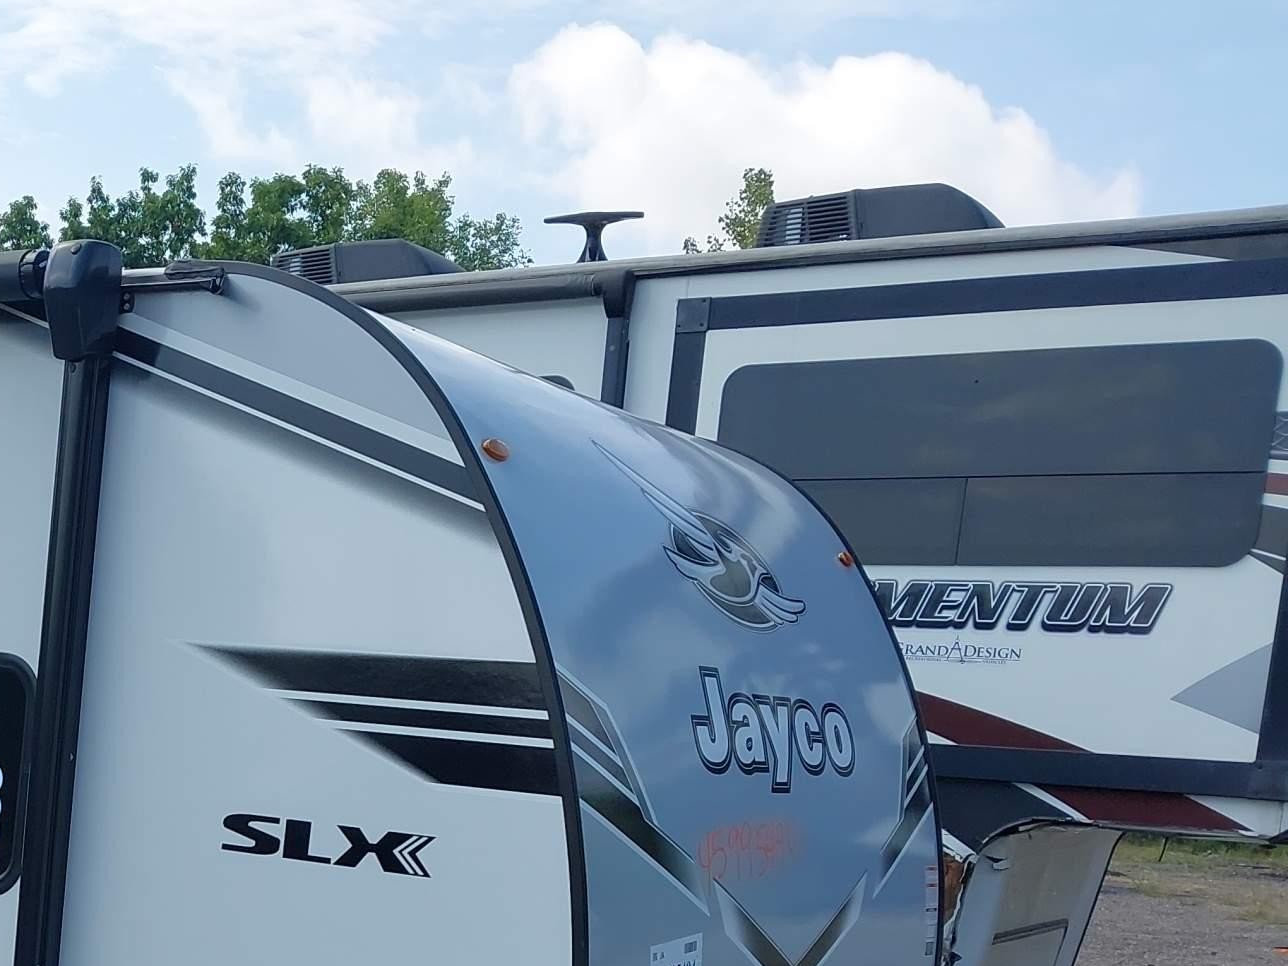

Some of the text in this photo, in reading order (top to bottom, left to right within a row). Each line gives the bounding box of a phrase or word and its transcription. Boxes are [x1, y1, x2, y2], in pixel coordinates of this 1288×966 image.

[870, 579, 1174, 635] MENTUM
[964, 644, 1022, 659] DESIGN
[690, 665, 855, 794] Jayco
[221, 813, 437, 878] SLX
